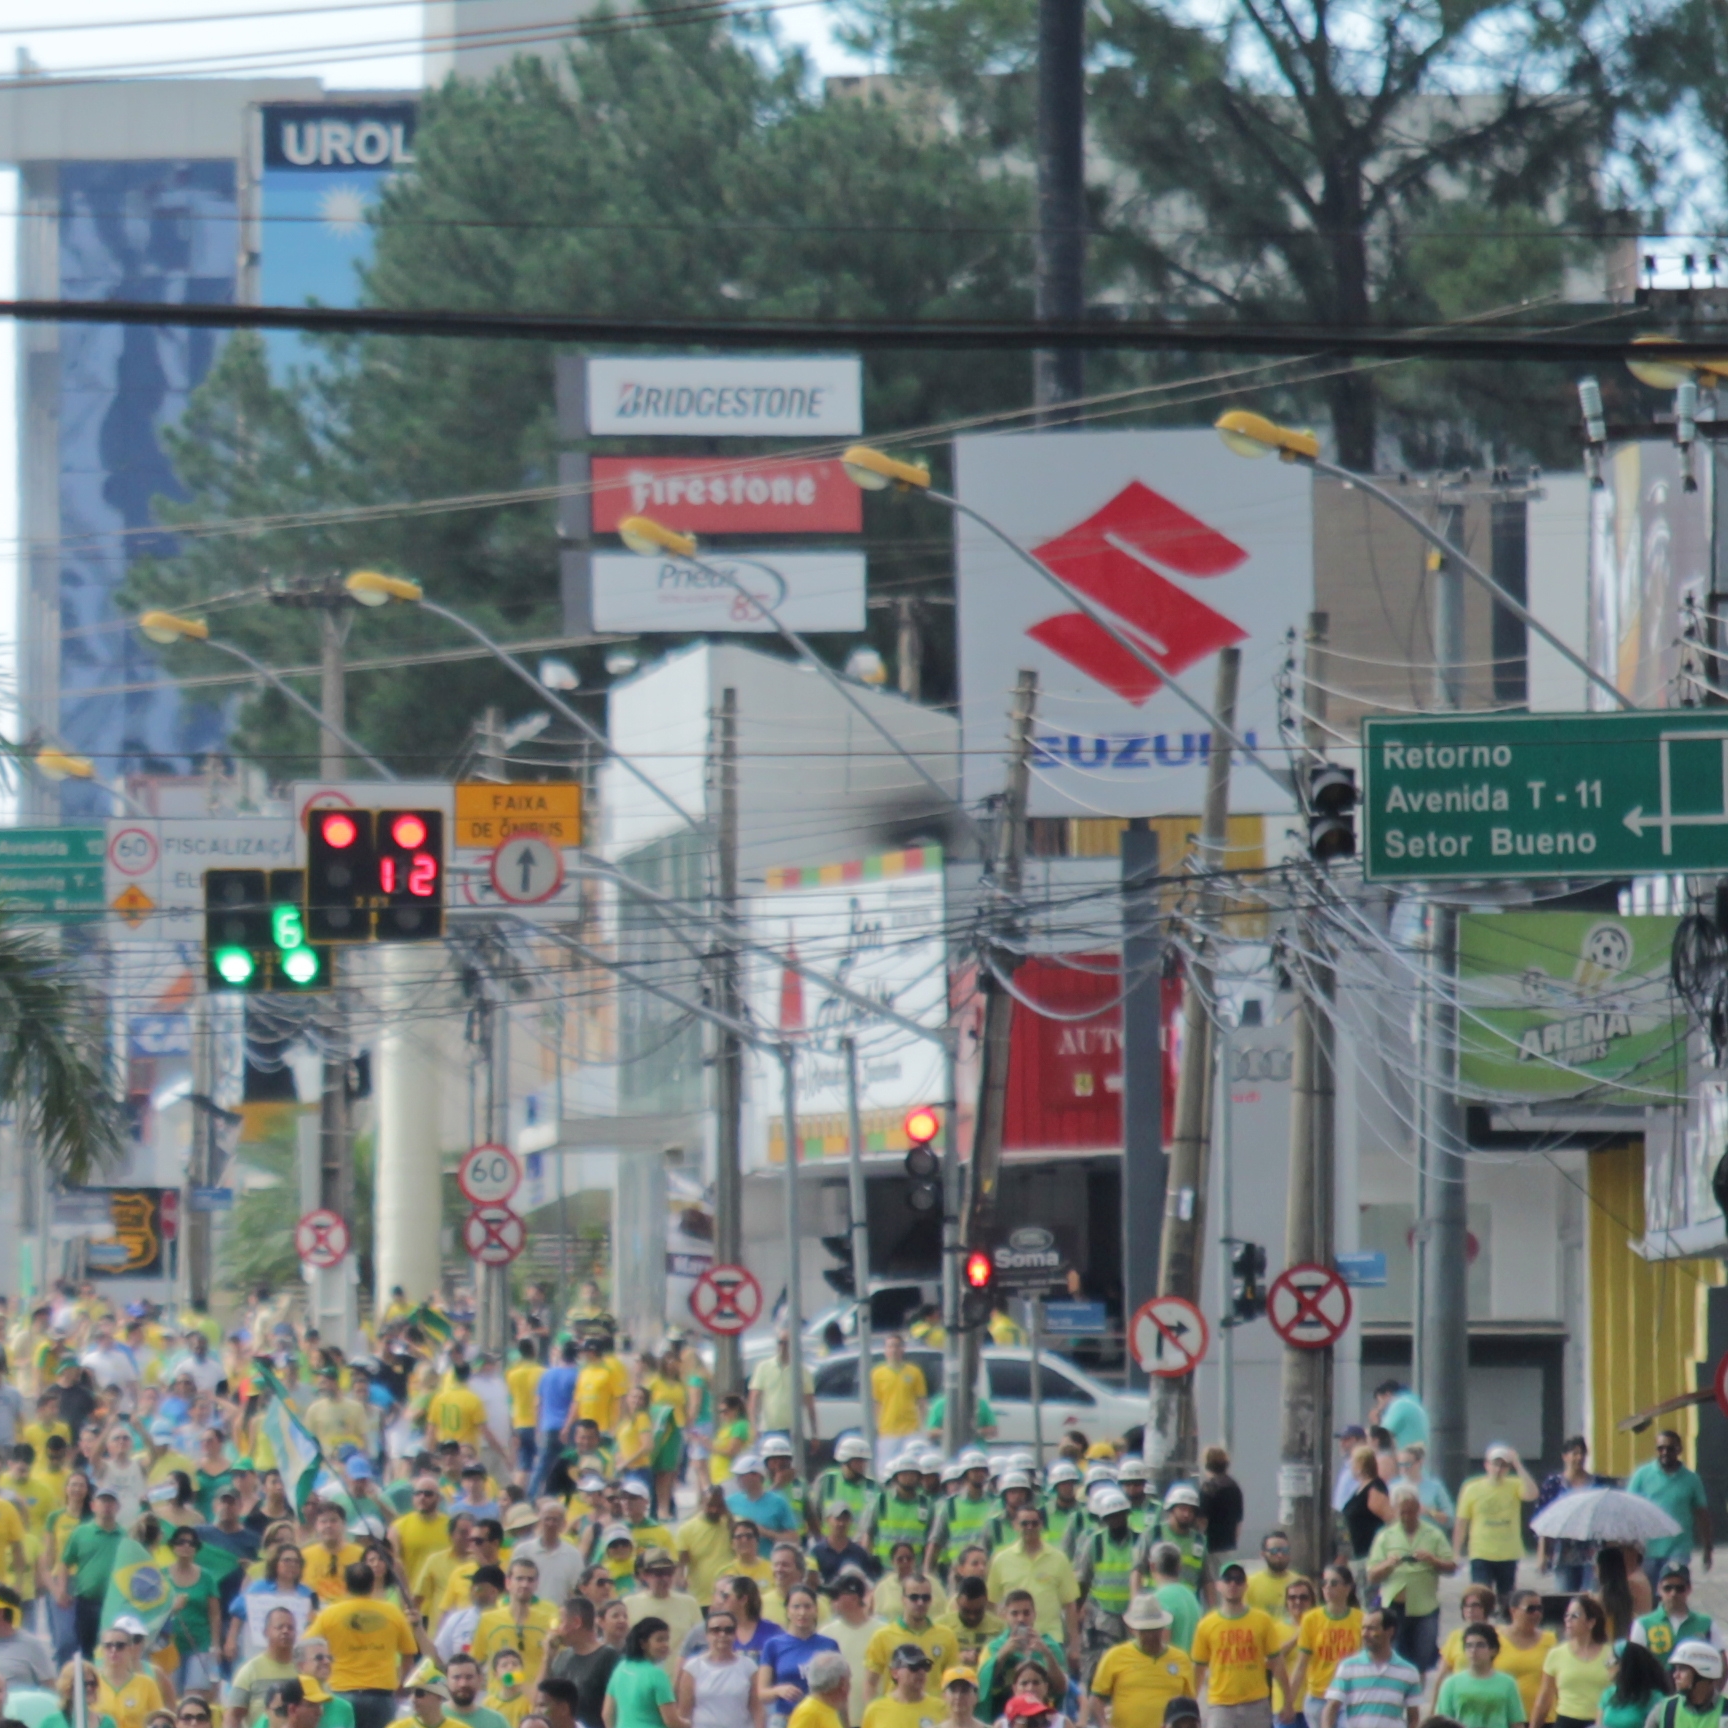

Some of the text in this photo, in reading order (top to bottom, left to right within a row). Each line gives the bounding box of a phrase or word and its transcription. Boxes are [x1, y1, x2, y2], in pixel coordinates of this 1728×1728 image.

[615, 383, 826, 418] BRIDGESTONE
[628, 470, 816, 514] Firestone
[1383, 740, 1512, 770] Retorno
[492, 794, 548, 811] FAIXA
[1385, 783, 1510, 813] Avenida
[1527, 780, 1546, 809] T
[1575, 778, 1602, 808] 11
[471, 822, 493, 839] DE
[1385, 827, 1597, 858] Setor Bueno
[118, 838, 147, 858] 60
[380, 854, 437, 897] 12
[274, 906, 303, 949] 6
[1517, 1013, 1631, 1062] ARENA
[471, 1157, 508, 1183] 60
[994, 1248, 1060, 1269] Soma
[1648, 1625, 1672, 1654] 9
